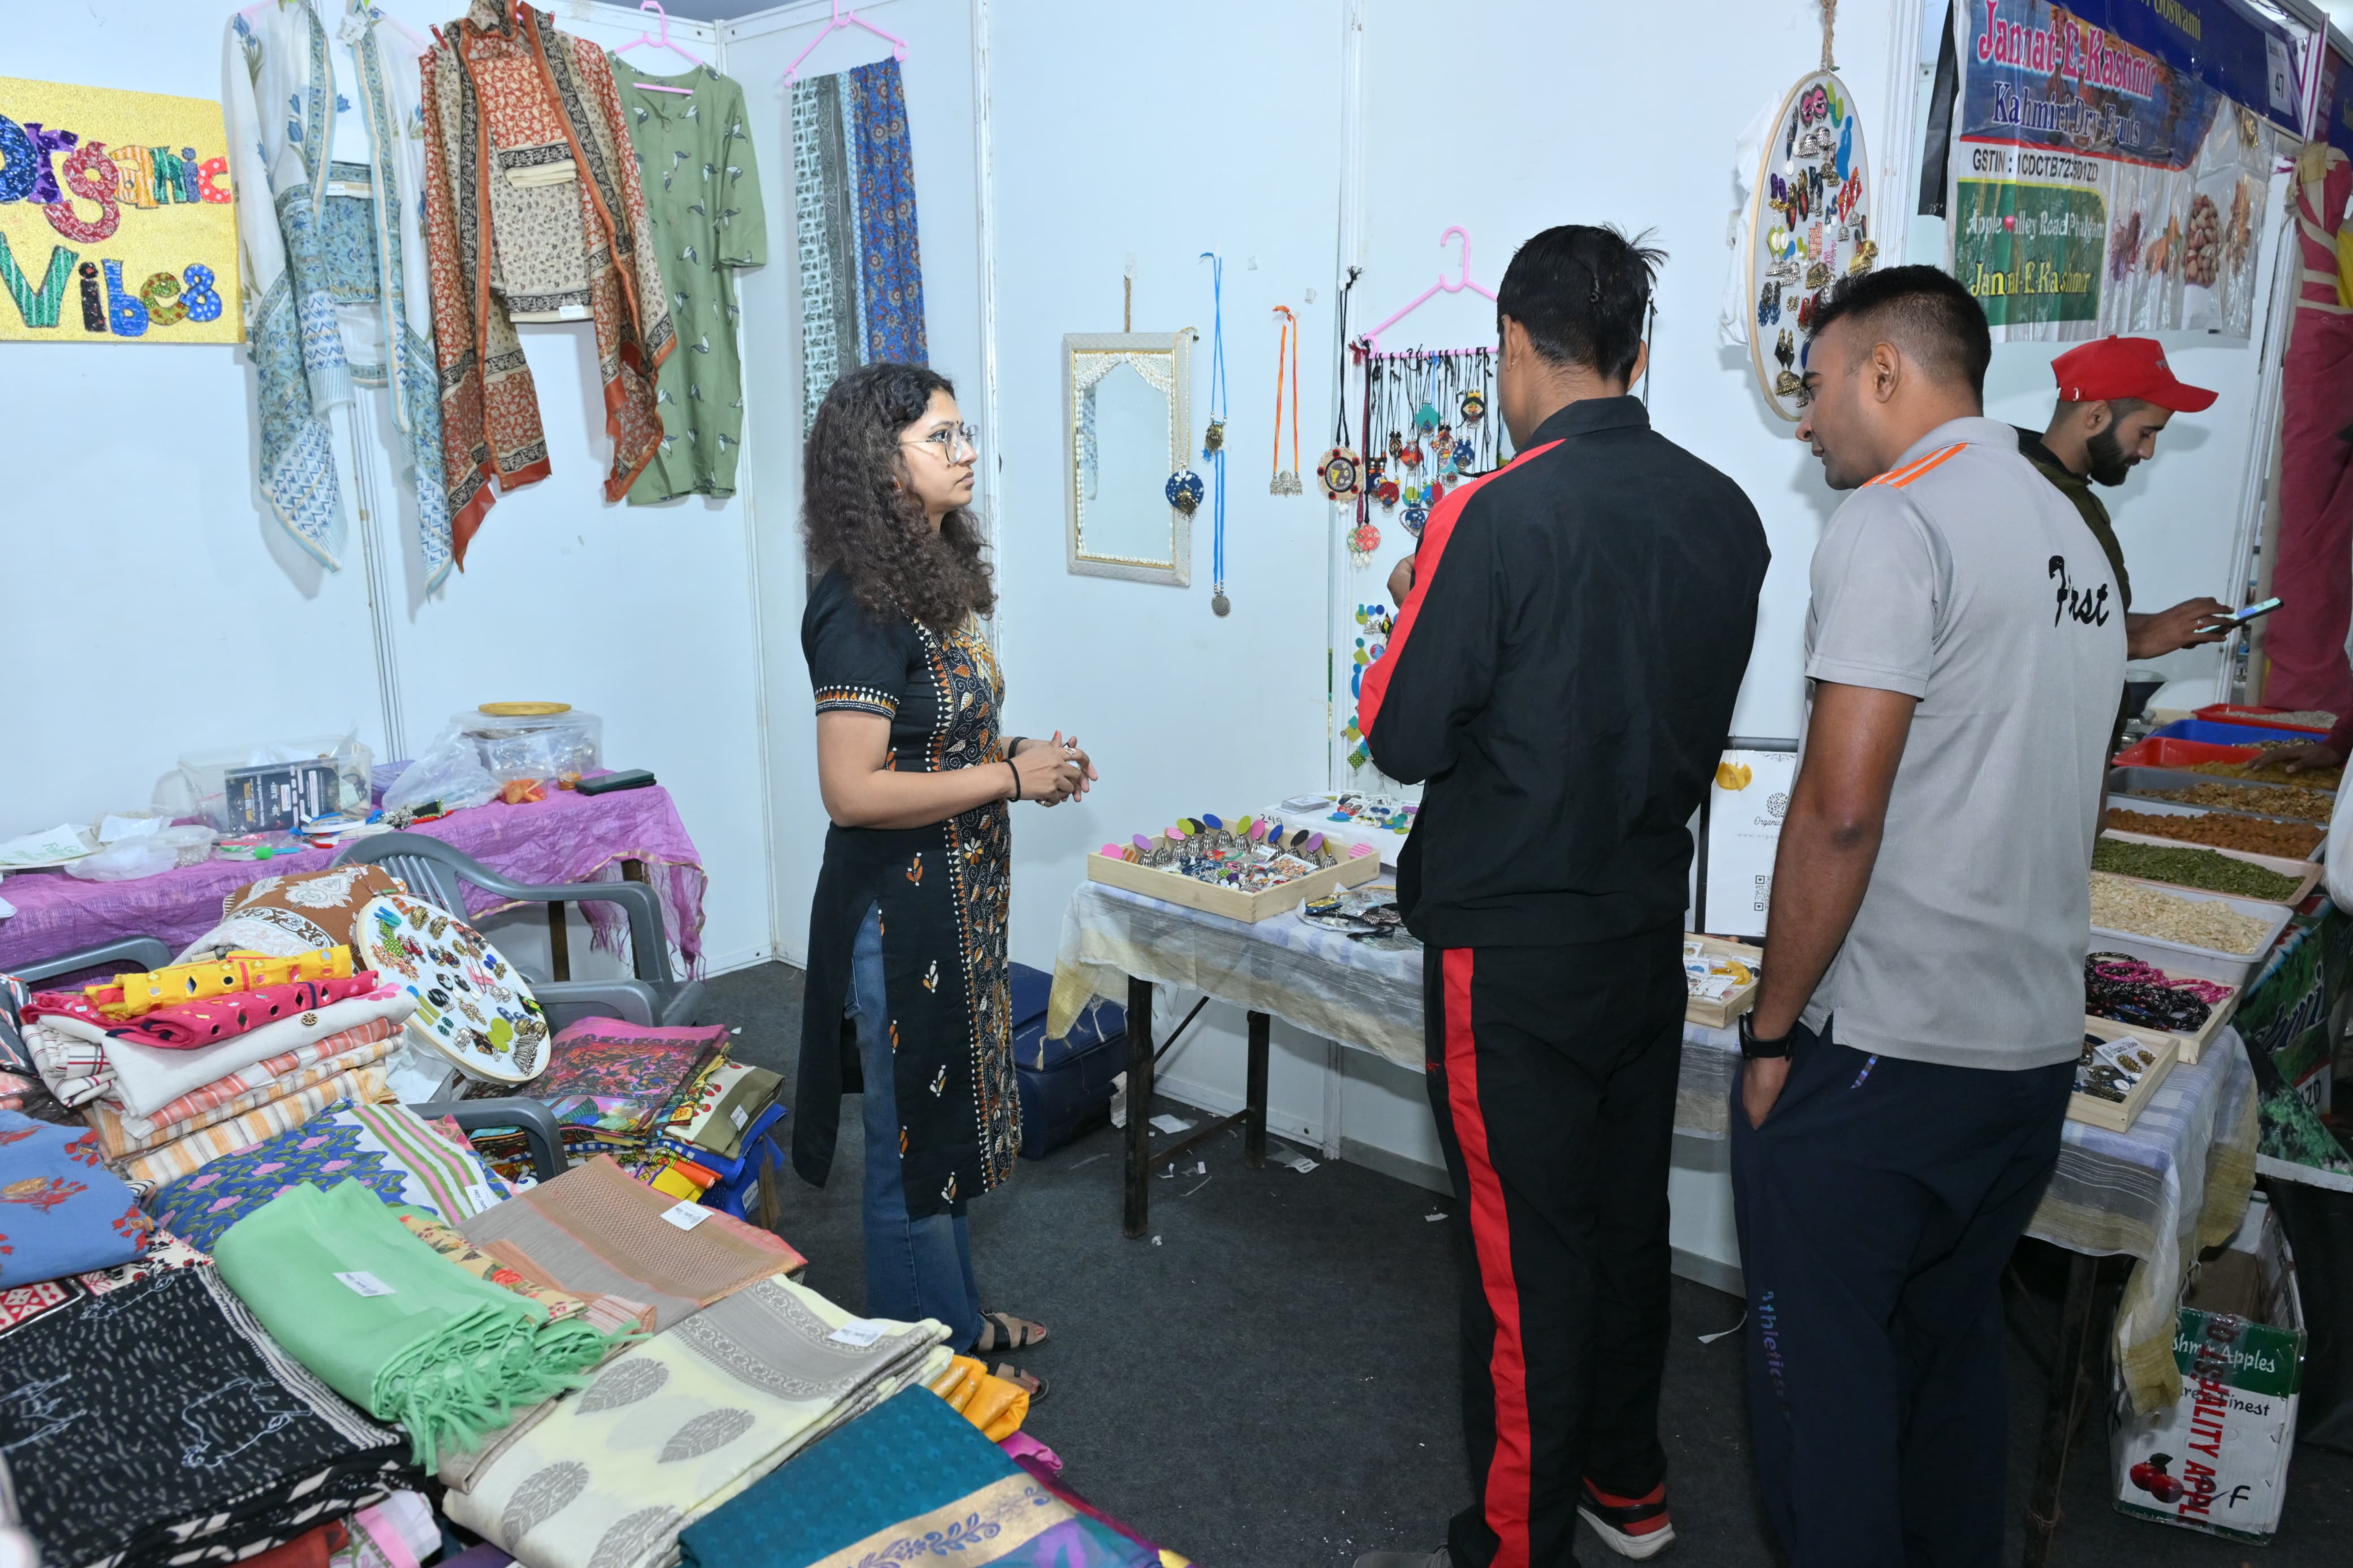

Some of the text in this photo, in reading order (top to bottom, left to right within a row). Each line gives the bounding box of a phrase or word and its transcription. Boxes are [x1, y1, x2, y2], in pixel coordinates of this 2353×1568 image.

[1978, 0, 2158, 100] Jannat-E-Kashmir
[2275, 72, 2284, 99] 47
[2072, 96, 2100, 148] Dry
[2101, 103, 2140, 147] Fruits
[1973, 148, 2006, 173] GSTIN
[1966, 209, 2002, 240] Apple
[2010, 210, 2037, 240] alley
[2039, 210, 2068, 236] Road
[2048, 555, 2110, 628] First
[1753, 816, 1782, 828] Organic
[2221, 1345, 2276, 1373] Apples
